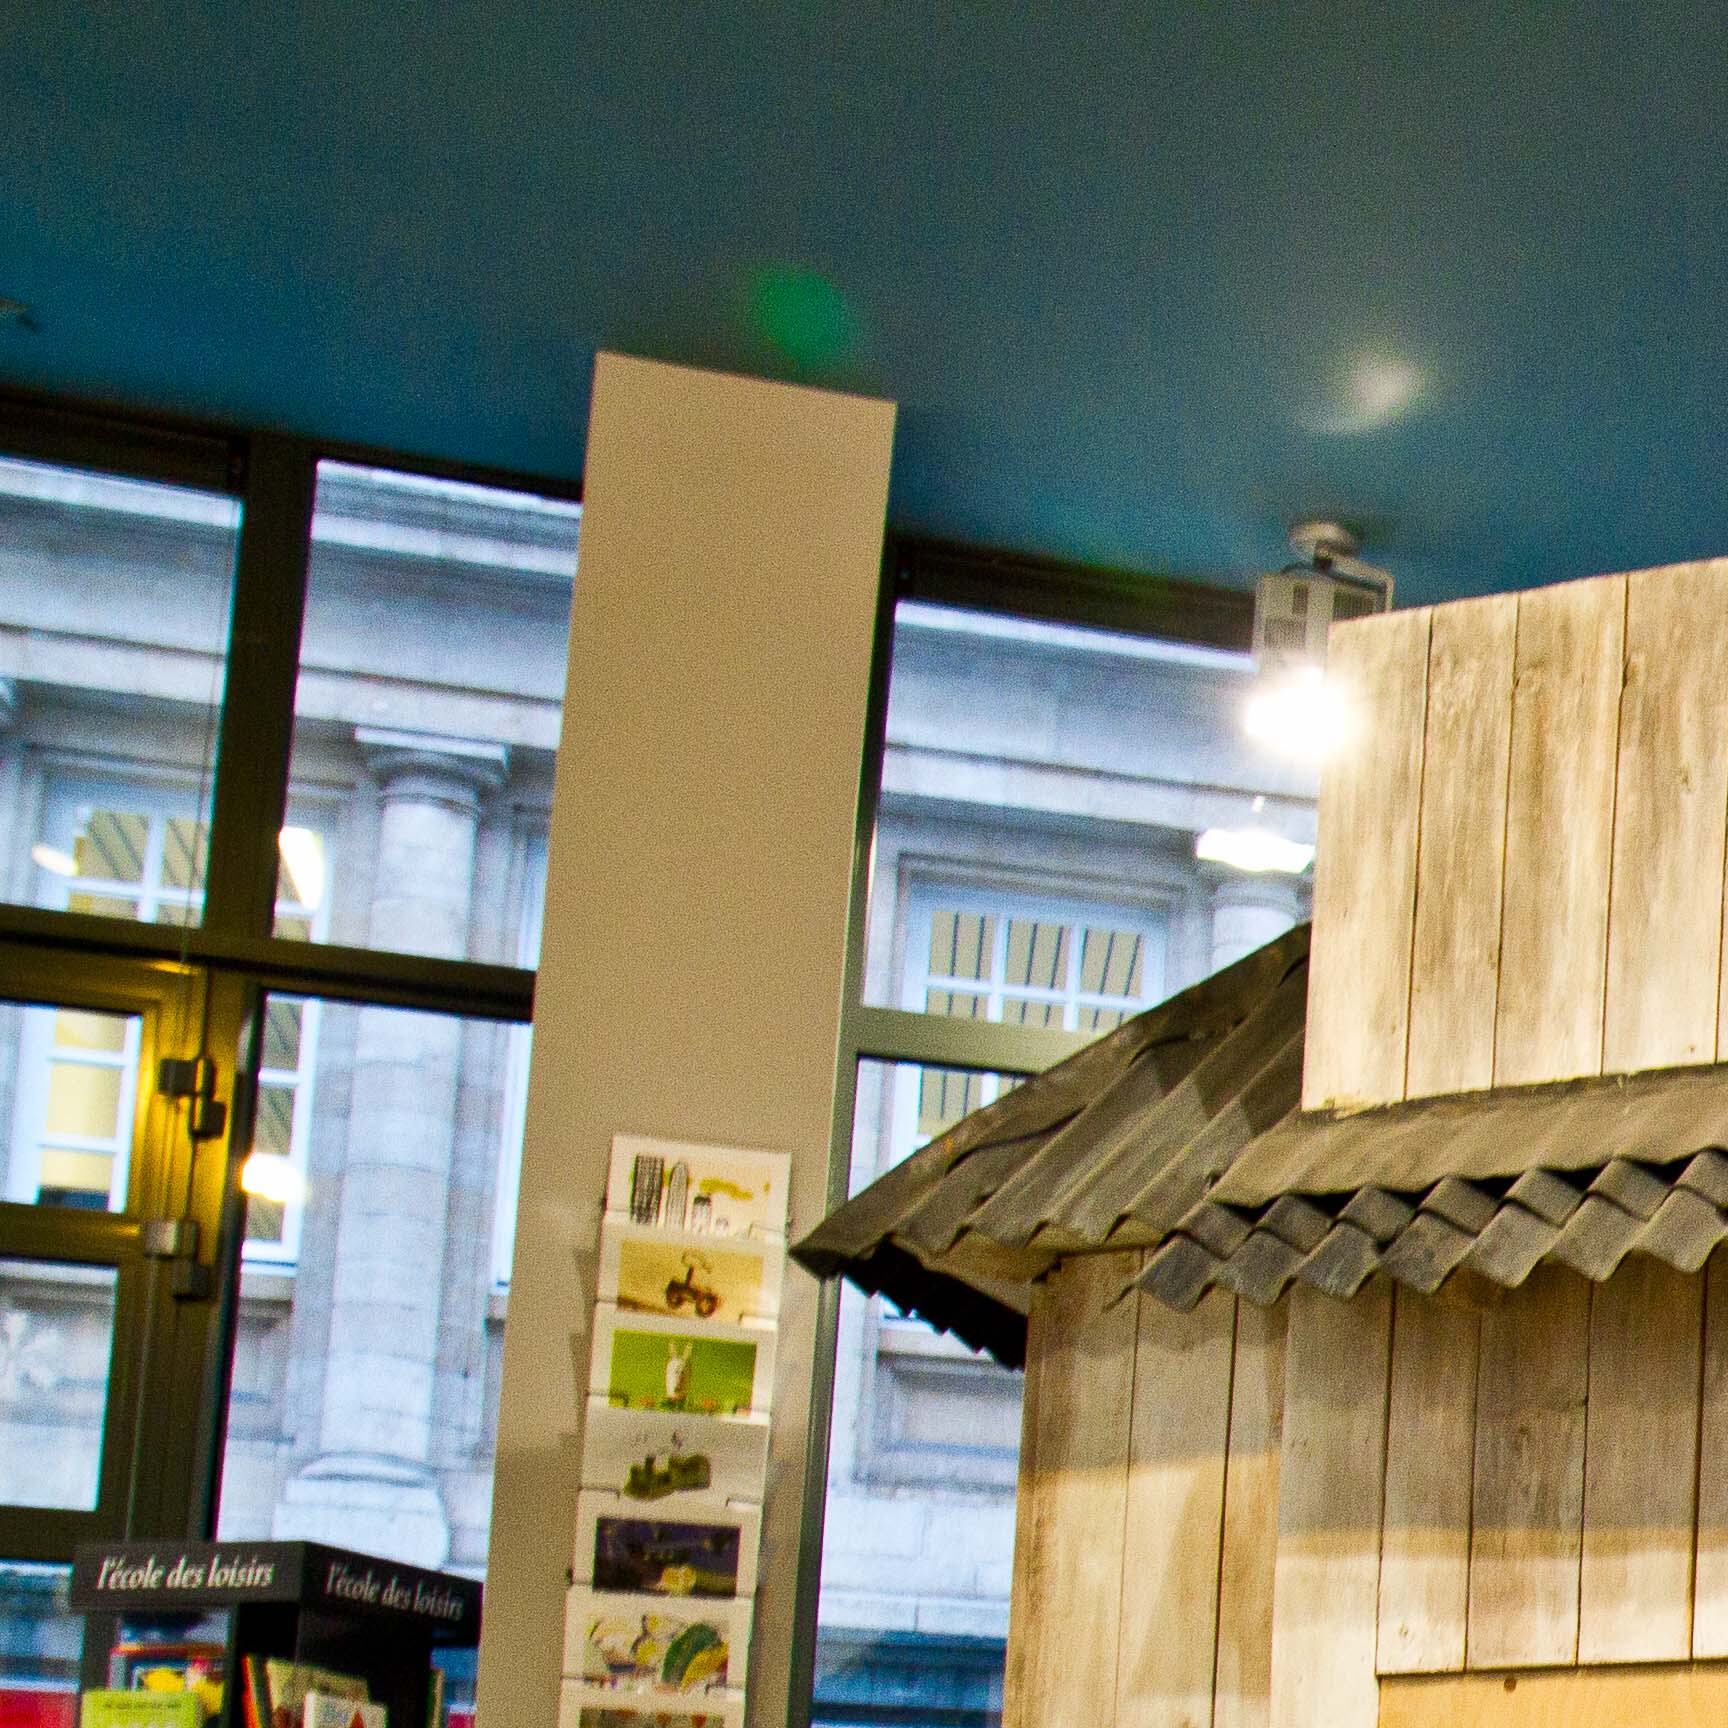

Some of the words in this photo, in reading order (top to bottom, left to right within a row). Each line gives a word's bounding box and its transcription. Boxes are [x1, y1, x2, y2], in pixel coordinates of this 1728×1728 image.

[97, 1553, 162, 1591] l'école
[165, 1557, 205, 1590] des
[207, 1553, 277, 1589] loisirs
[324, 1562, 381, 1599] l'école
[382, 1579, 413, 1611] des
[414, 1580, 464, 1621] loisirs
